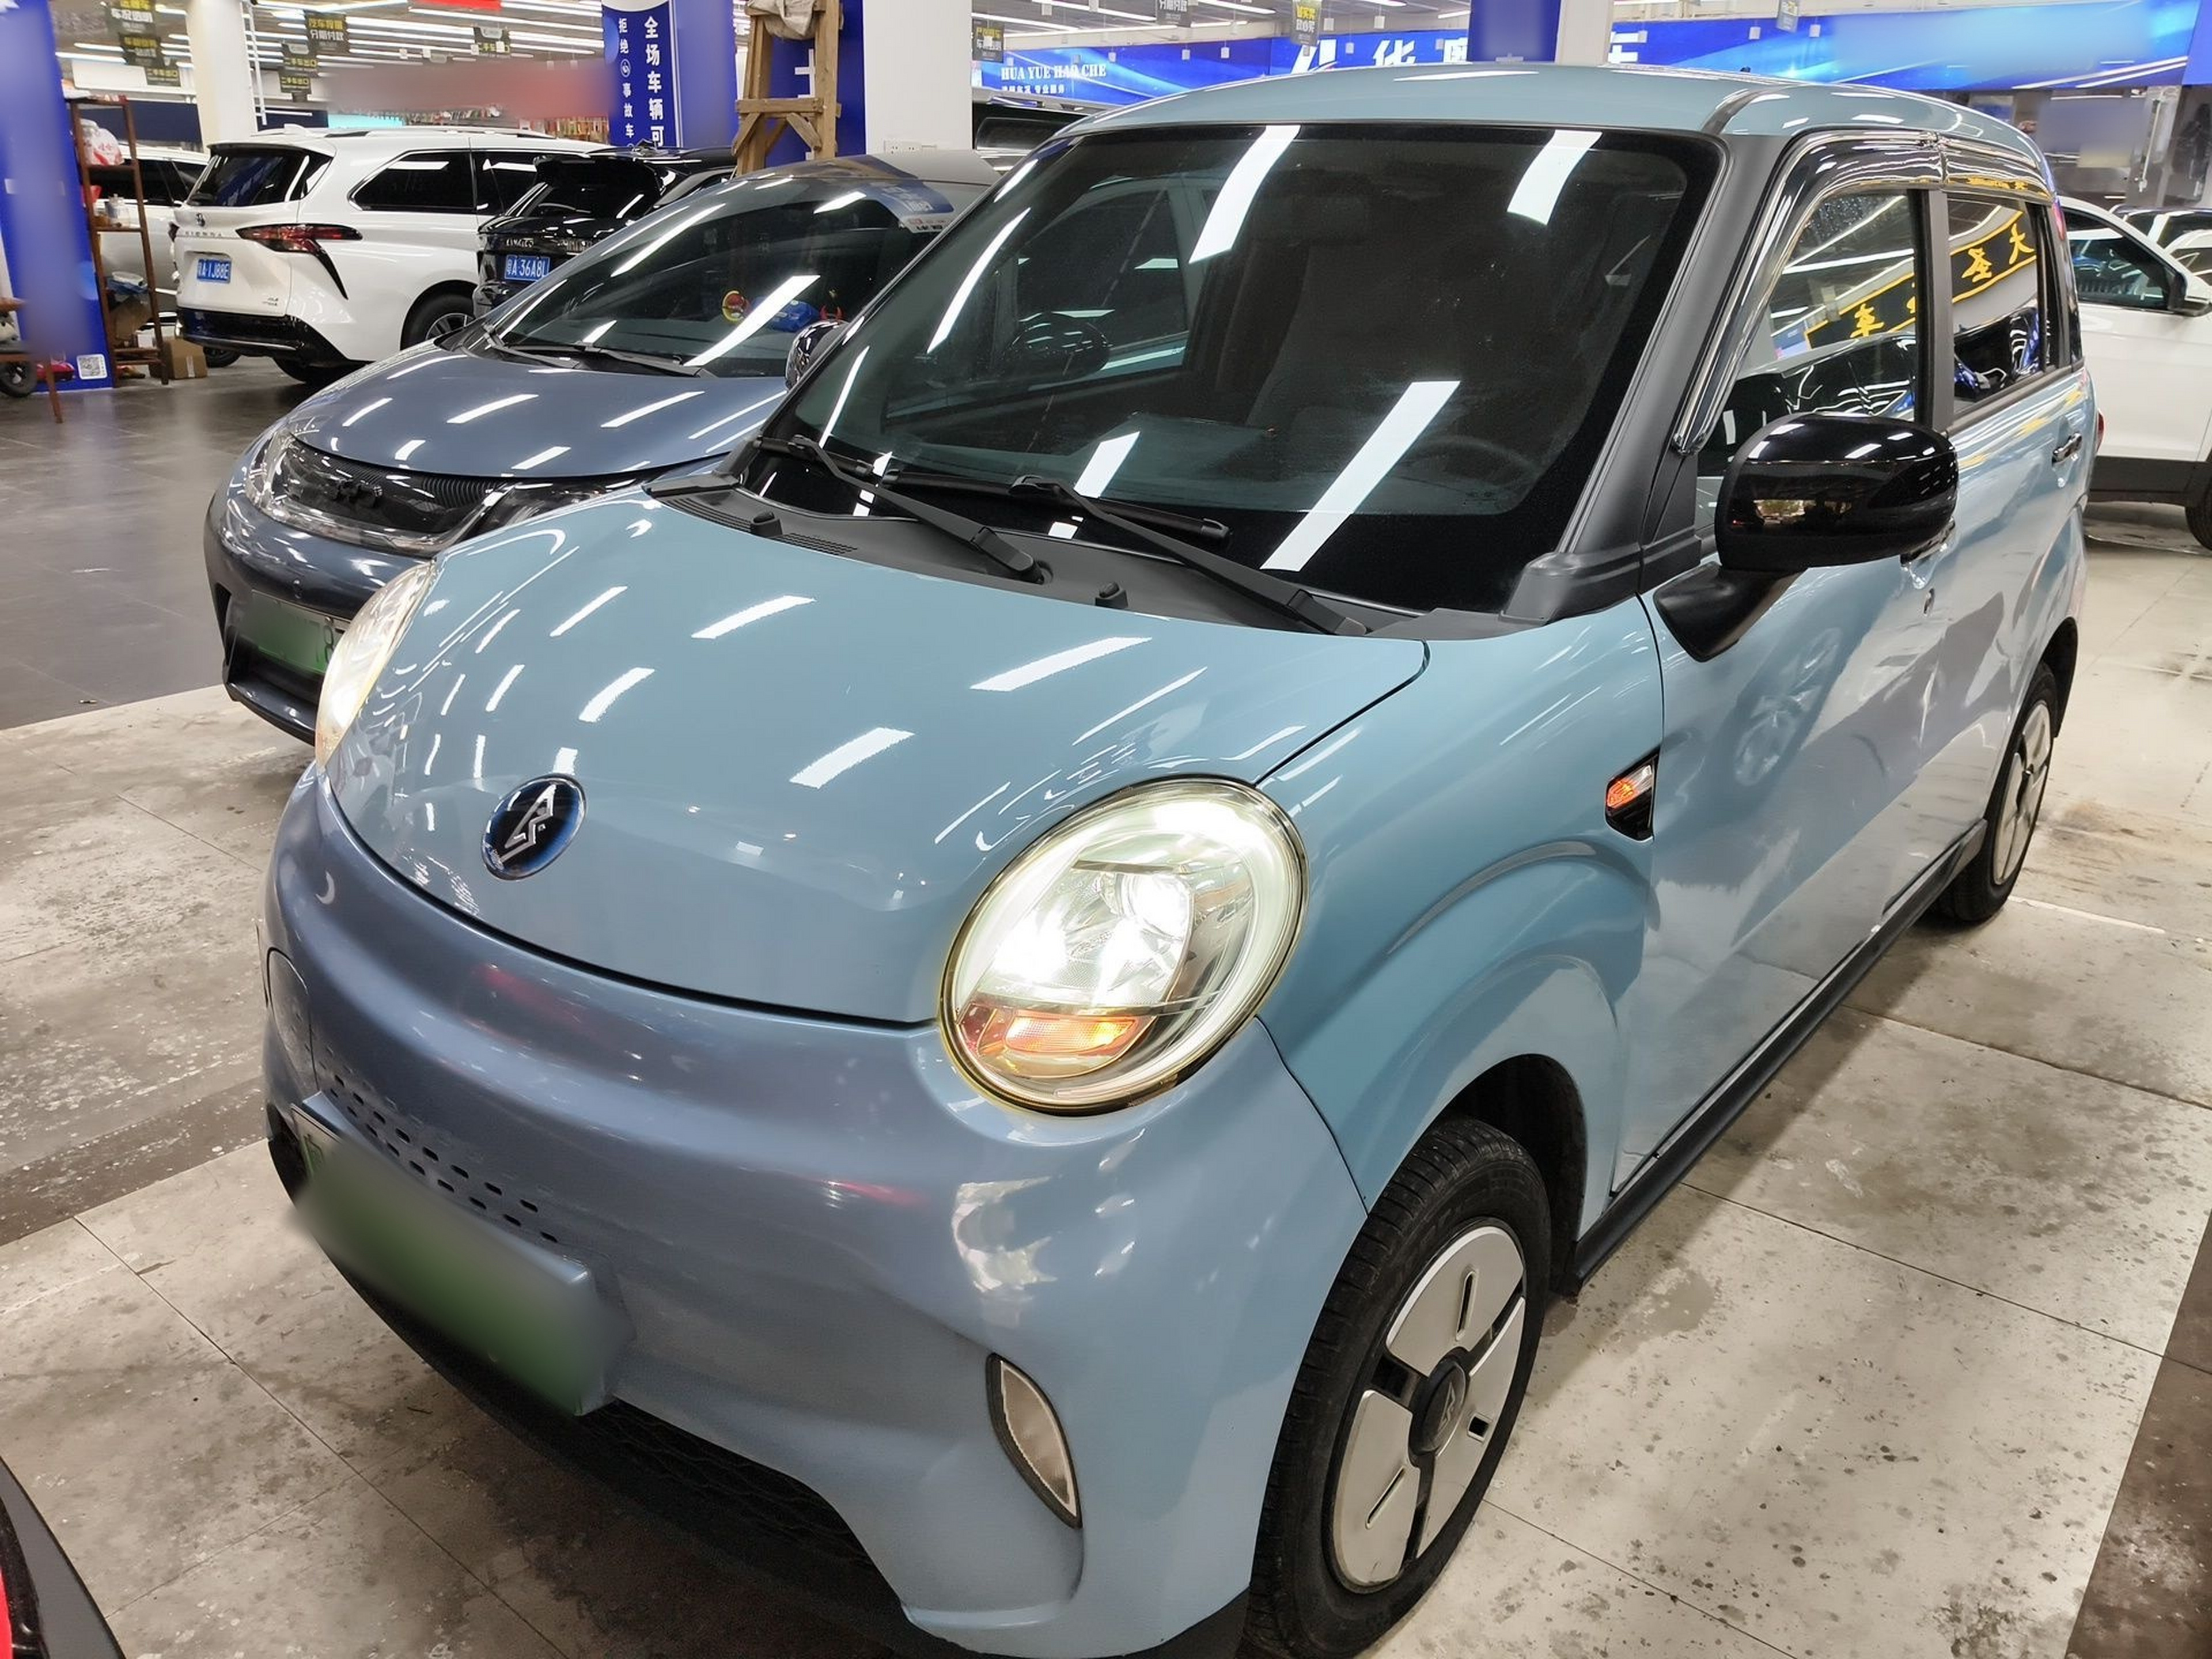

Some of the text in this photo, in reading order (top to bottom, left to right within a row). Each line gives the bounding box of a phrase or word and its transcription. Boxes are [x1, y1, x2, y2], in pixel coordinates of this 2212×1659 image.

[619, 18, 634, 138] 拒绝 事故车
[644, 16, 664, 147] 全场车辆可
[1001, 67, 1025, 81] HUA
[1028, 66, 1051, 79] YUE
[1081, 63, 1107, 78] CHE
